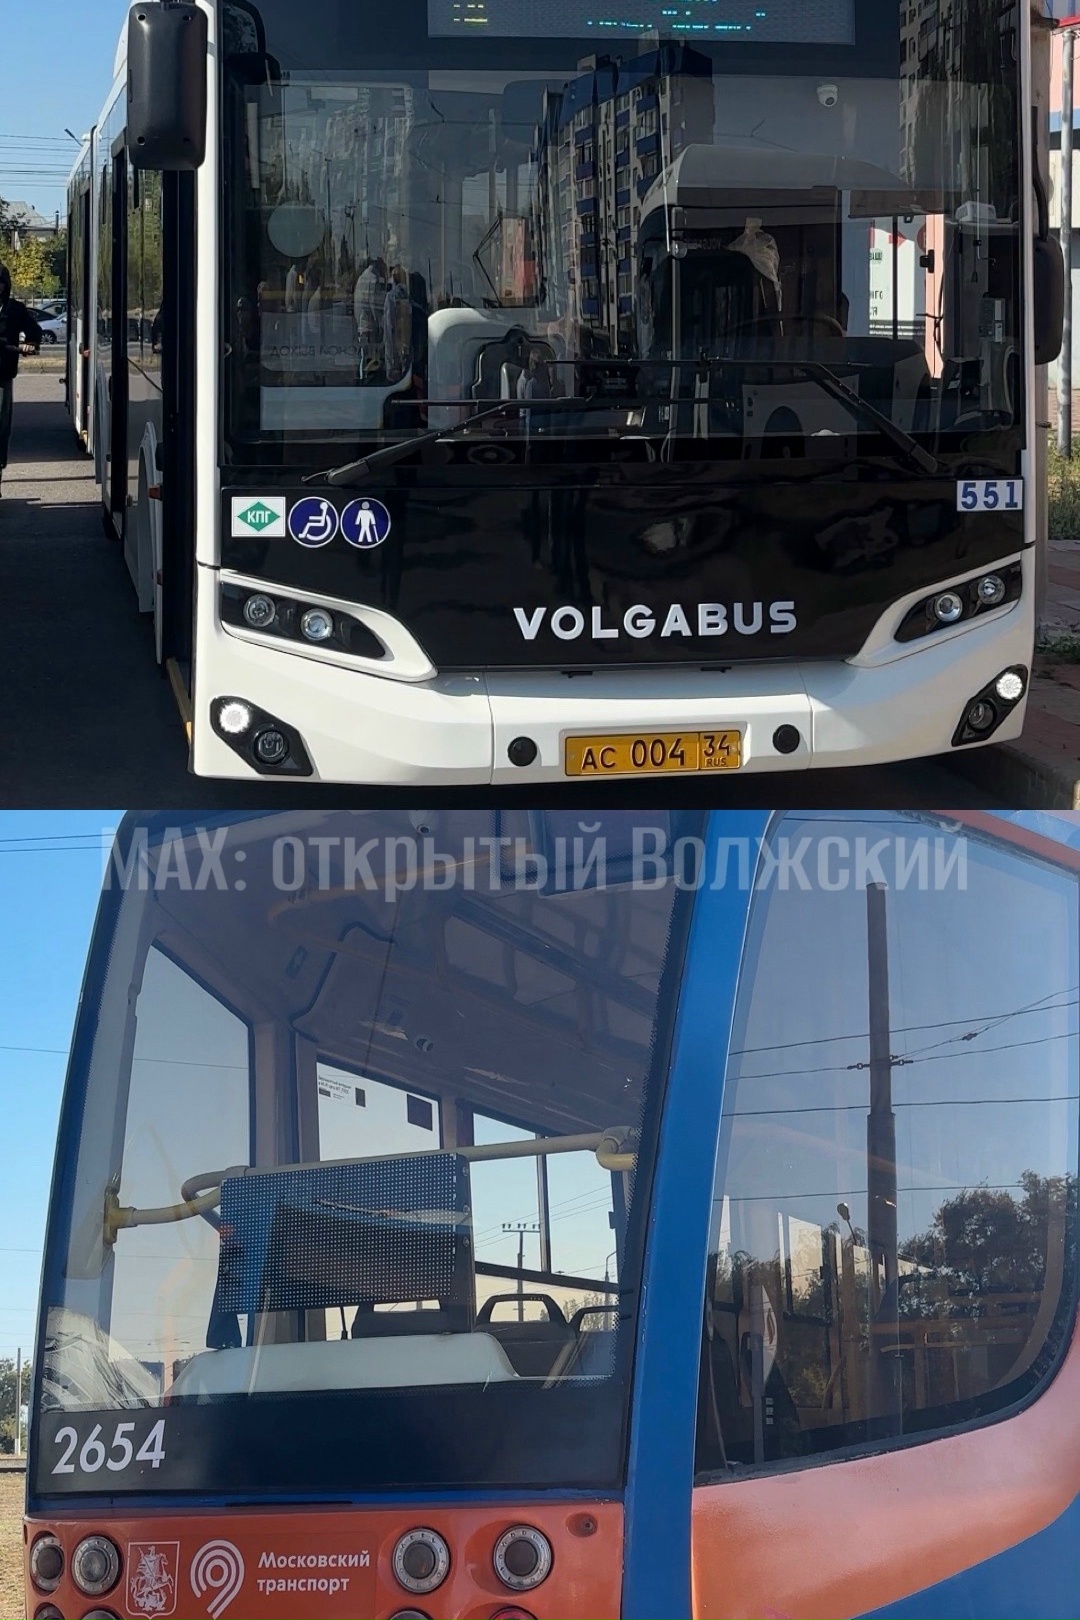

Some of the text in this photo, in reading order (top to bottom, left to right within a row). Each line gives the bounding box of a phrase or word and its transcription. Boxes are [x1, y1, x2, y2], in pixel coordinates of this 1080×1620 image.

[961, 481, 1018, 510] 551
[247, 510, 271, 523] КПГ
[513, 600, 797, 640] VOLGABUS
[631, 738, 685, 768] 004
[703, 735, 730, 757] 34
[706, 756, 728, 768] RUS
[51, 1419, 166, 1475] 2654
[258, 1549, 370, 1569] Московский
[257, 1578, 350, 1596] транспорт
